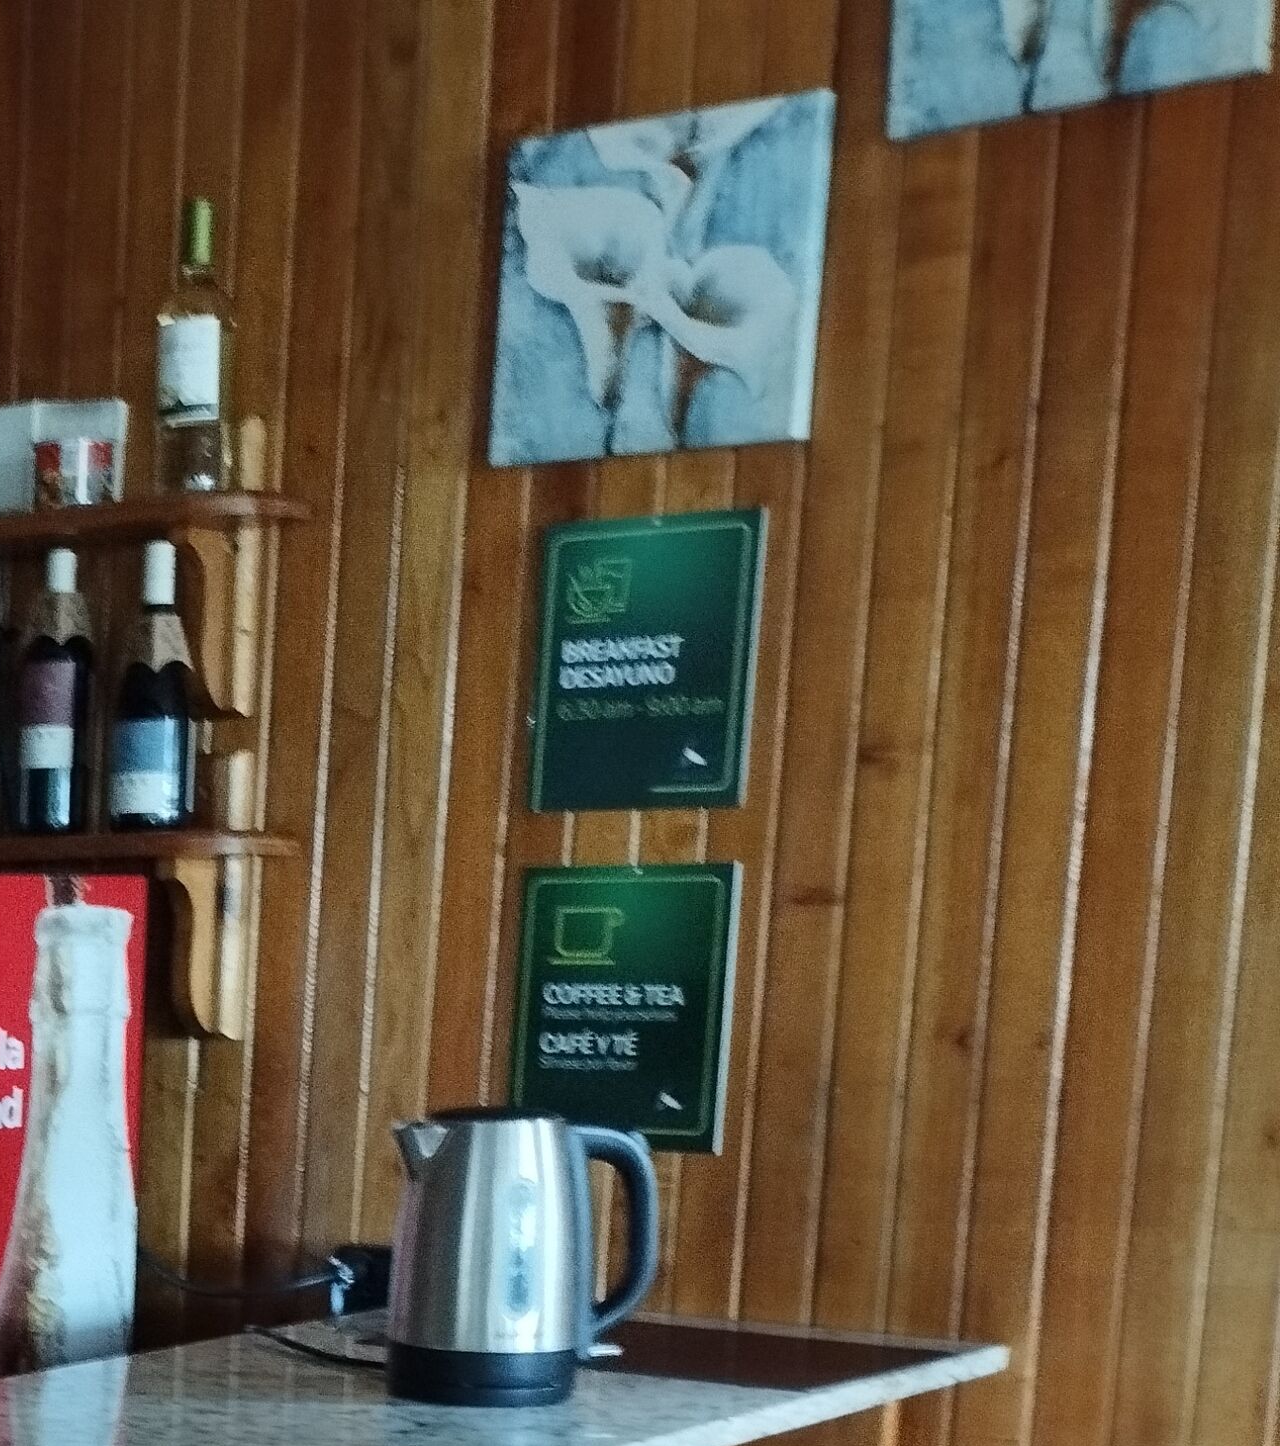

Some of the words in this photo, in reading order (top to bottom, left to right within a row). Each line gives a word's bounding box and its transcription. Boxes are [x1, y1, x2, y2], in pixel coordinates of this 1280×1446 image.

[560, 633, 685, 662] BREAKFAST
[558, 661, 676, 689] DESAYUNO
[542, 982, 624, 1006] COFFEE
[643, 983, 685, 1007] TEA
[595, 1034, 612, 1055] Y
